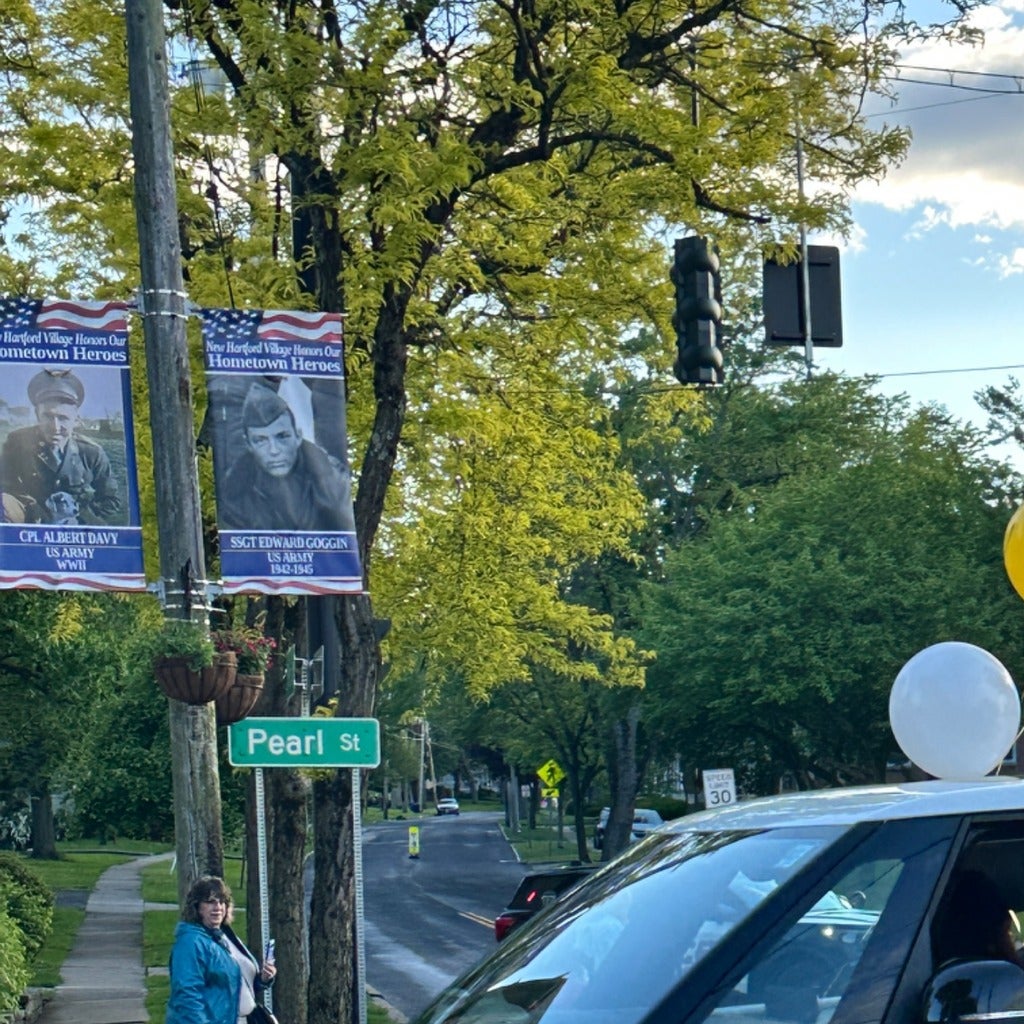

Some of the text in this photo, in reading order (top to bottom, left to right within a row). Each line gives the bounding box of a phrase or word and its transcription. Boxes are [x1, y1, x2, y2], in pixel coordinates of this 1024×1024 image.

[4, 331, 41, 346] Hartford
[44, 332, 73, 347] Village
[75, 333, 107, 346] Honors
[109, 334, 126, 346] Our
[0, 346, 127, 361] ometown Heroes
[206, 340, 341, 357] New Hartford Village Honors Our
[208, 353, 341, 372] Hometown Heroes
[19, 530, 118, 544] CPL ALBERT DAVY
[230, 536, 348, 549] SSGT EDWARD GOGGIN
[45, 547, 95, 559] US ARMY
[267, 552, 314, 562] US ARMY
[56, 559, 86, 570] WWII
[270, 564, 314, 575] 1942-1945
[248, 728, 360, 756] Pearl St
[710, 790, 732, 805] 30
